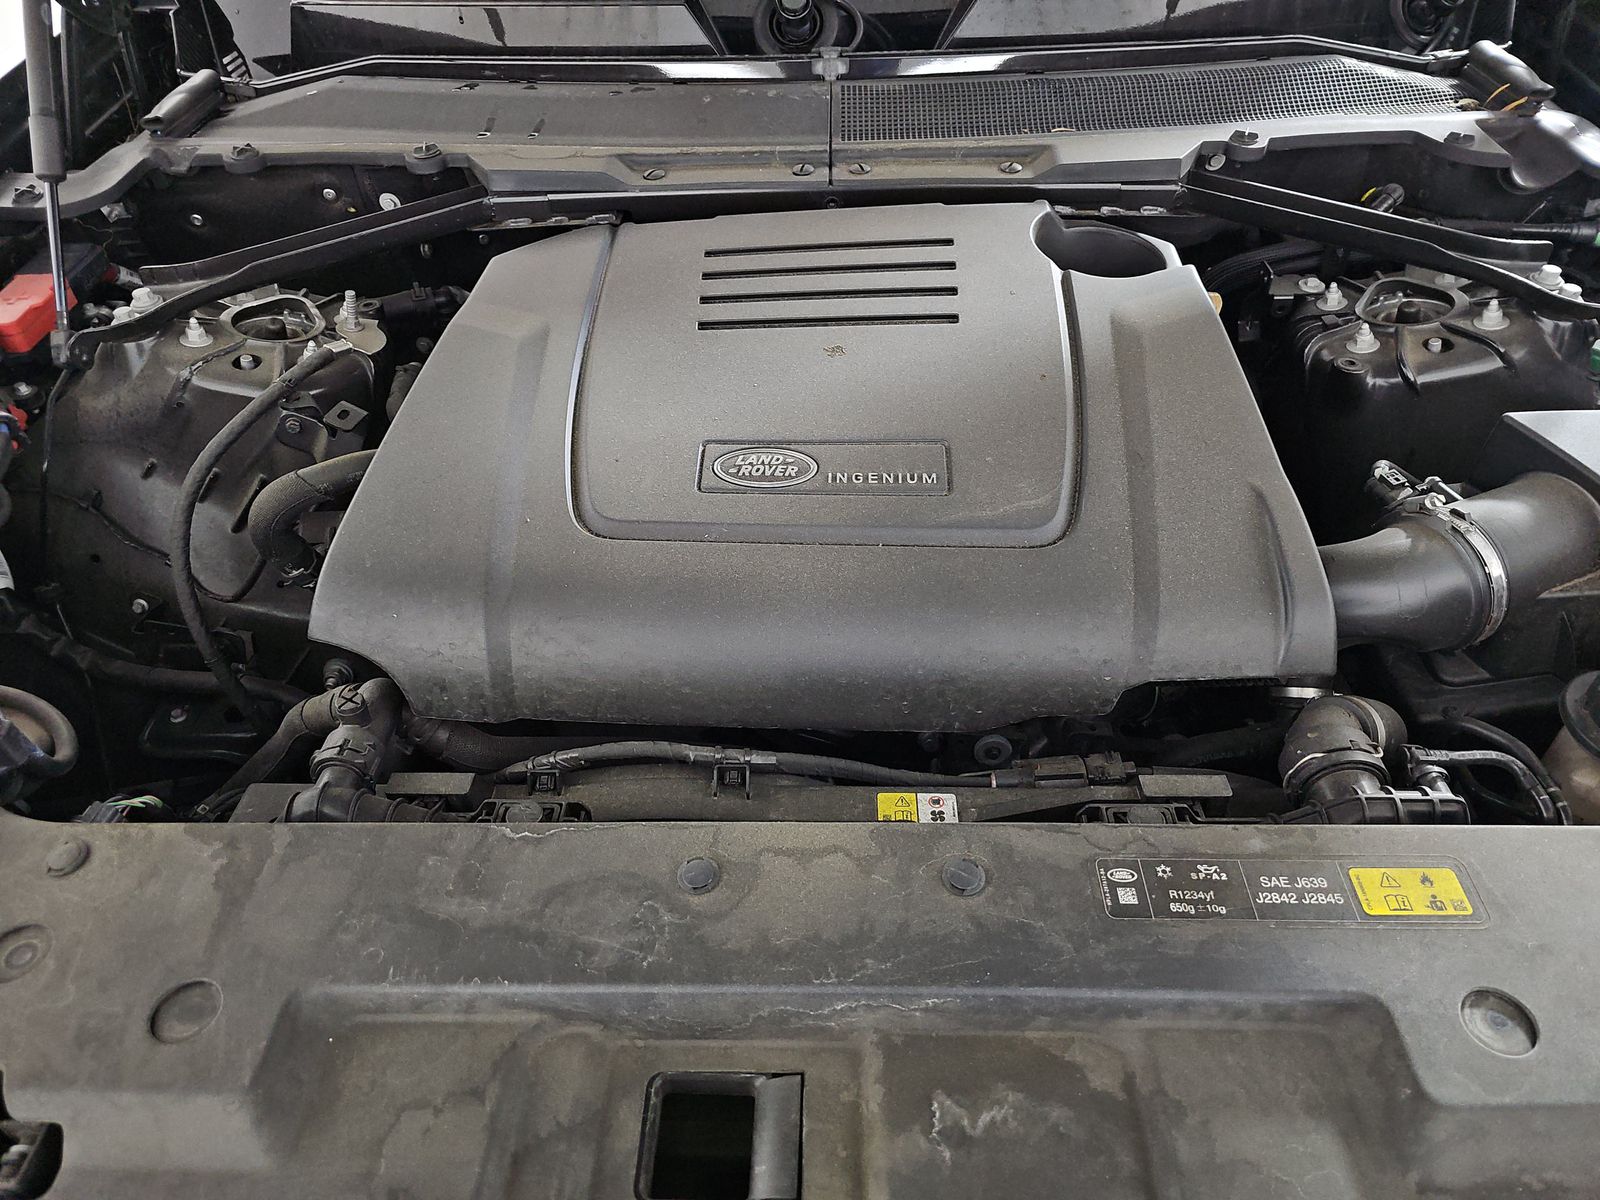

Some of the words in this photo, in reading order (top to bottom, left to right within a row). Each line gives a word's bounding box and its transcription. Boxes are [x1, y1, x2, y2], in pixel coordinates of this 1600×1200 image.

[827, 472, 937, 484] INGENIUM
[1190, 872, 1228, 880] SP-A2
[1260, 876, 1291, 888] SAE
[1294, 877, 1328, 888] J639
[1168, 889, 1215, 902] R1234yf
[1255, 892, 1298, 904] J2842
[1301, 893, 1344, 904] J2845
[1169, 902, 1196, 914] 650g
